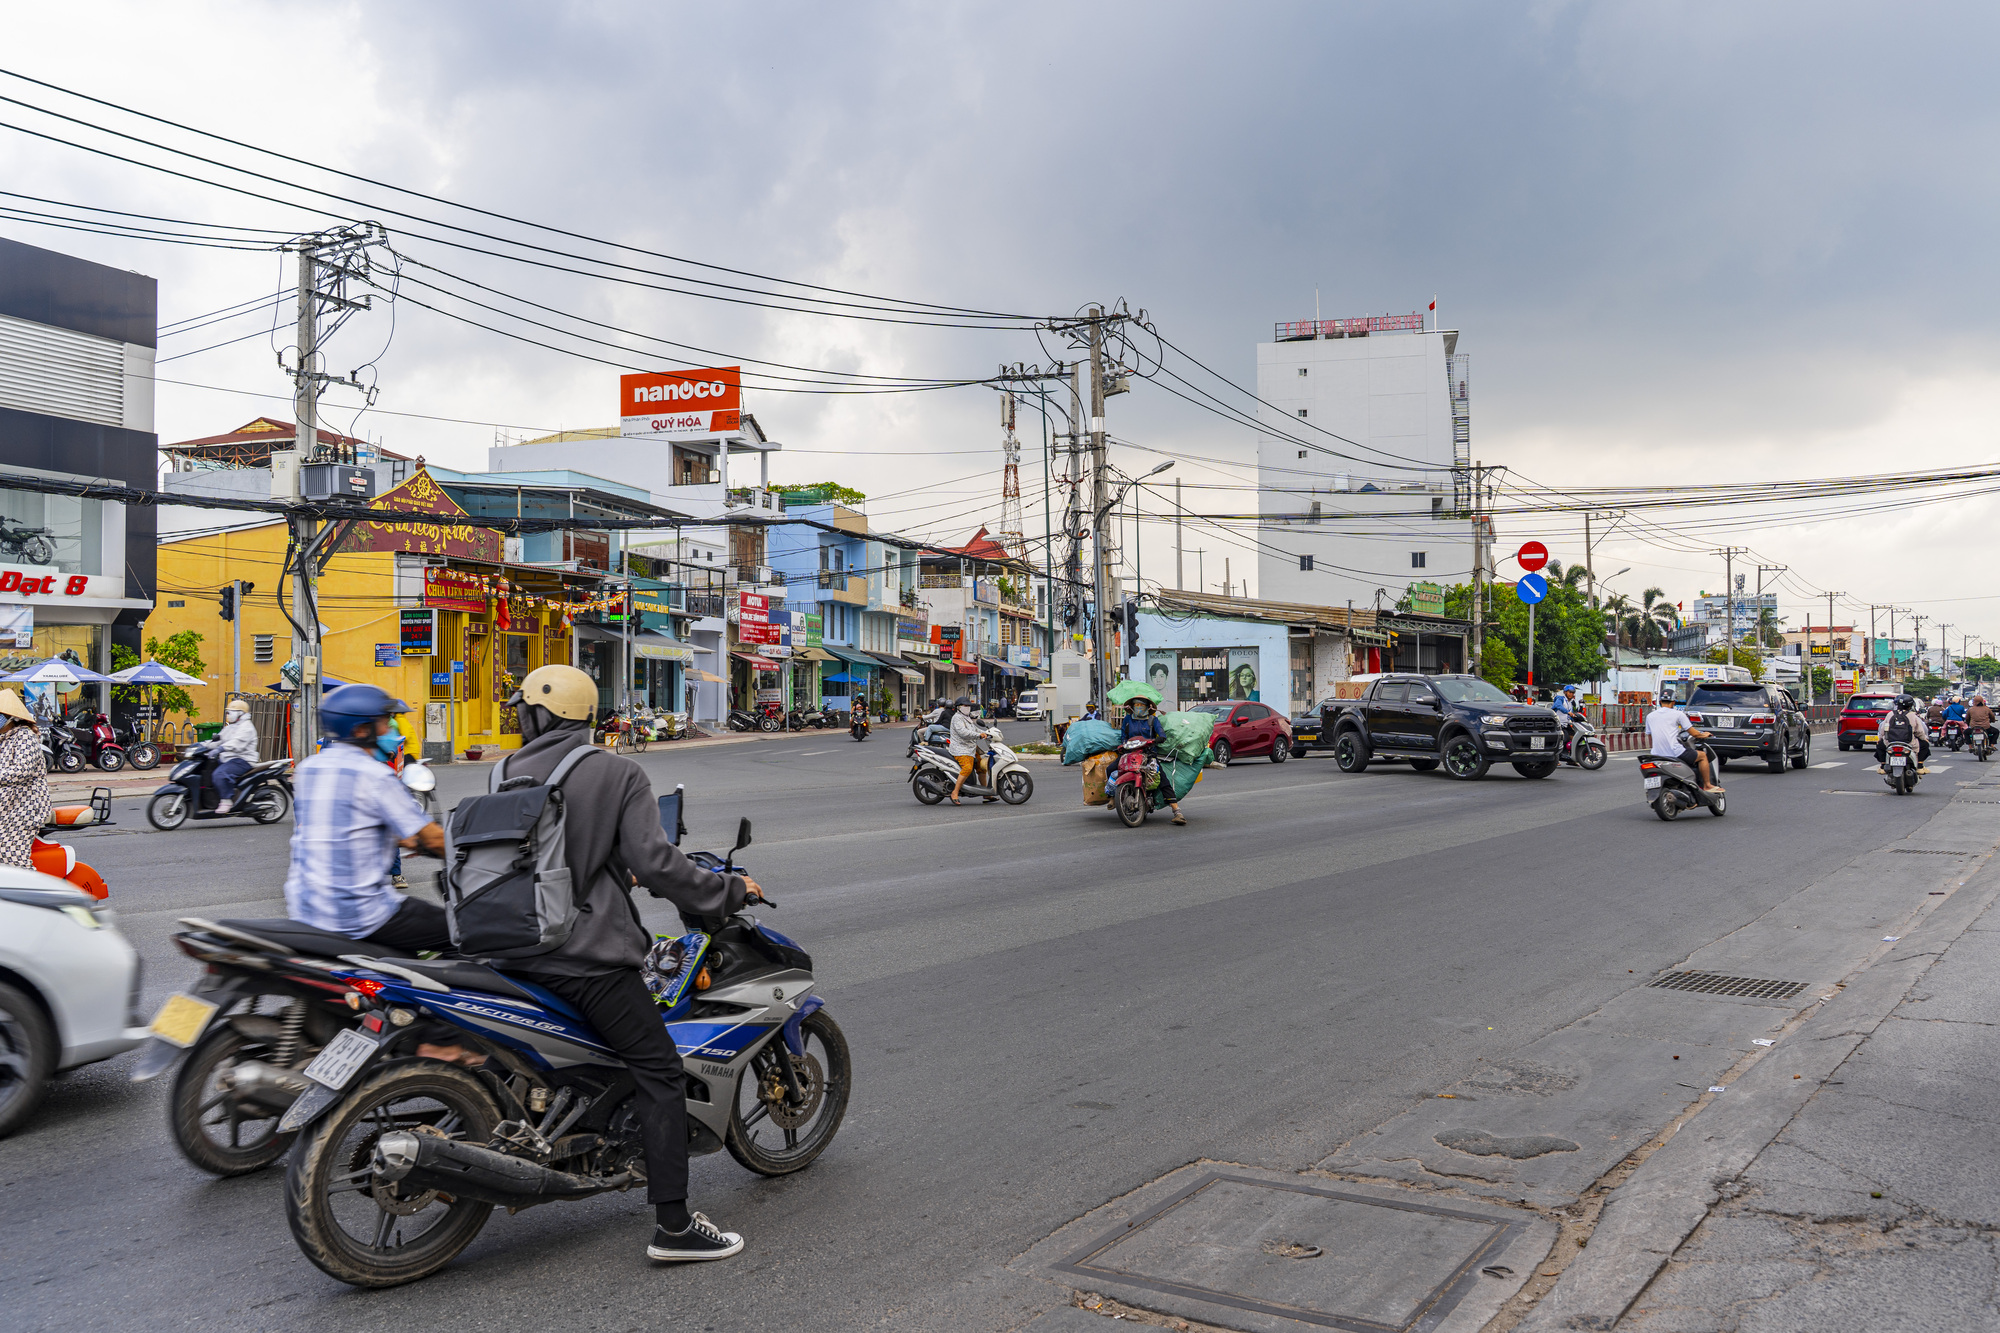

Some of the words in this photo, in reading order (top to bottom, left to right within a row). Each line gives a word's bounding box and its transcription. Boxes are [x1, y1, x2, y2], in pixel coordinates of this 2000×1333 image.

[634, 380, 726, 403] nanoco
[651, 417, 675, 430] QUÝ
[677, 415, 702, 427] HÓA
[0, 571, 57, 596] Đạt
[65, 575, 89, 595] 8
[427, 580, 446, 597] CHÙA
[447, 583, 462, 600] LIÊN
[1812, 645, 1830, 654] NỆM
[454, 1001, 534, 1026] EXCITER
[534, 1021, 567, 1032] GP
[701, 1063, 735, 1079] YAMAHA
